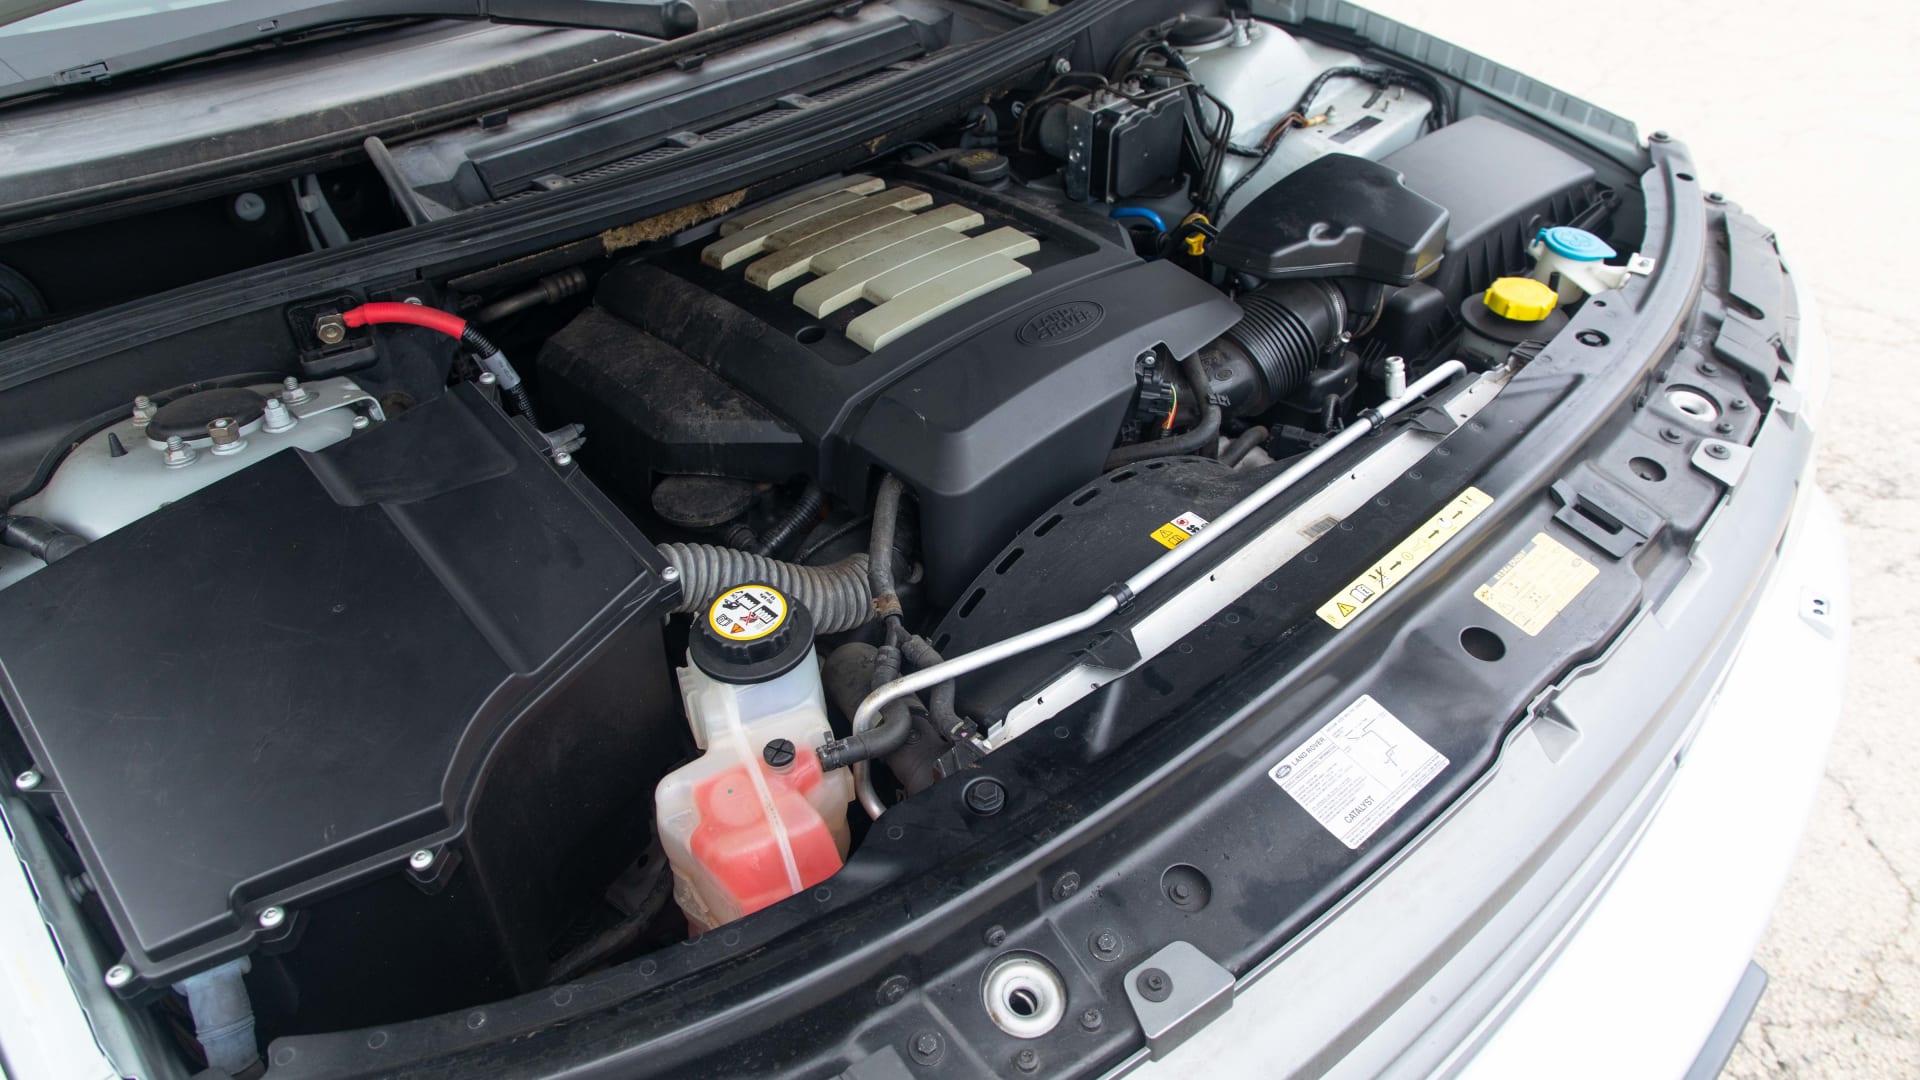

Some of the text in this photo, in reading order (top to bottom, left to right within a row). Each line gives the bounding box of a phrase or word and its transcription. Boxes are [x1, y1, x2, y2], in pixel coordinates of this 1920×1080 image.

[1041, 308, 1070, 327] LAND
[1046, 310, 1093, 337] ROVER
[1291, 736, 1325, 766] LAND ROVER
[1344, 795, 1374, 823] CATALYST
